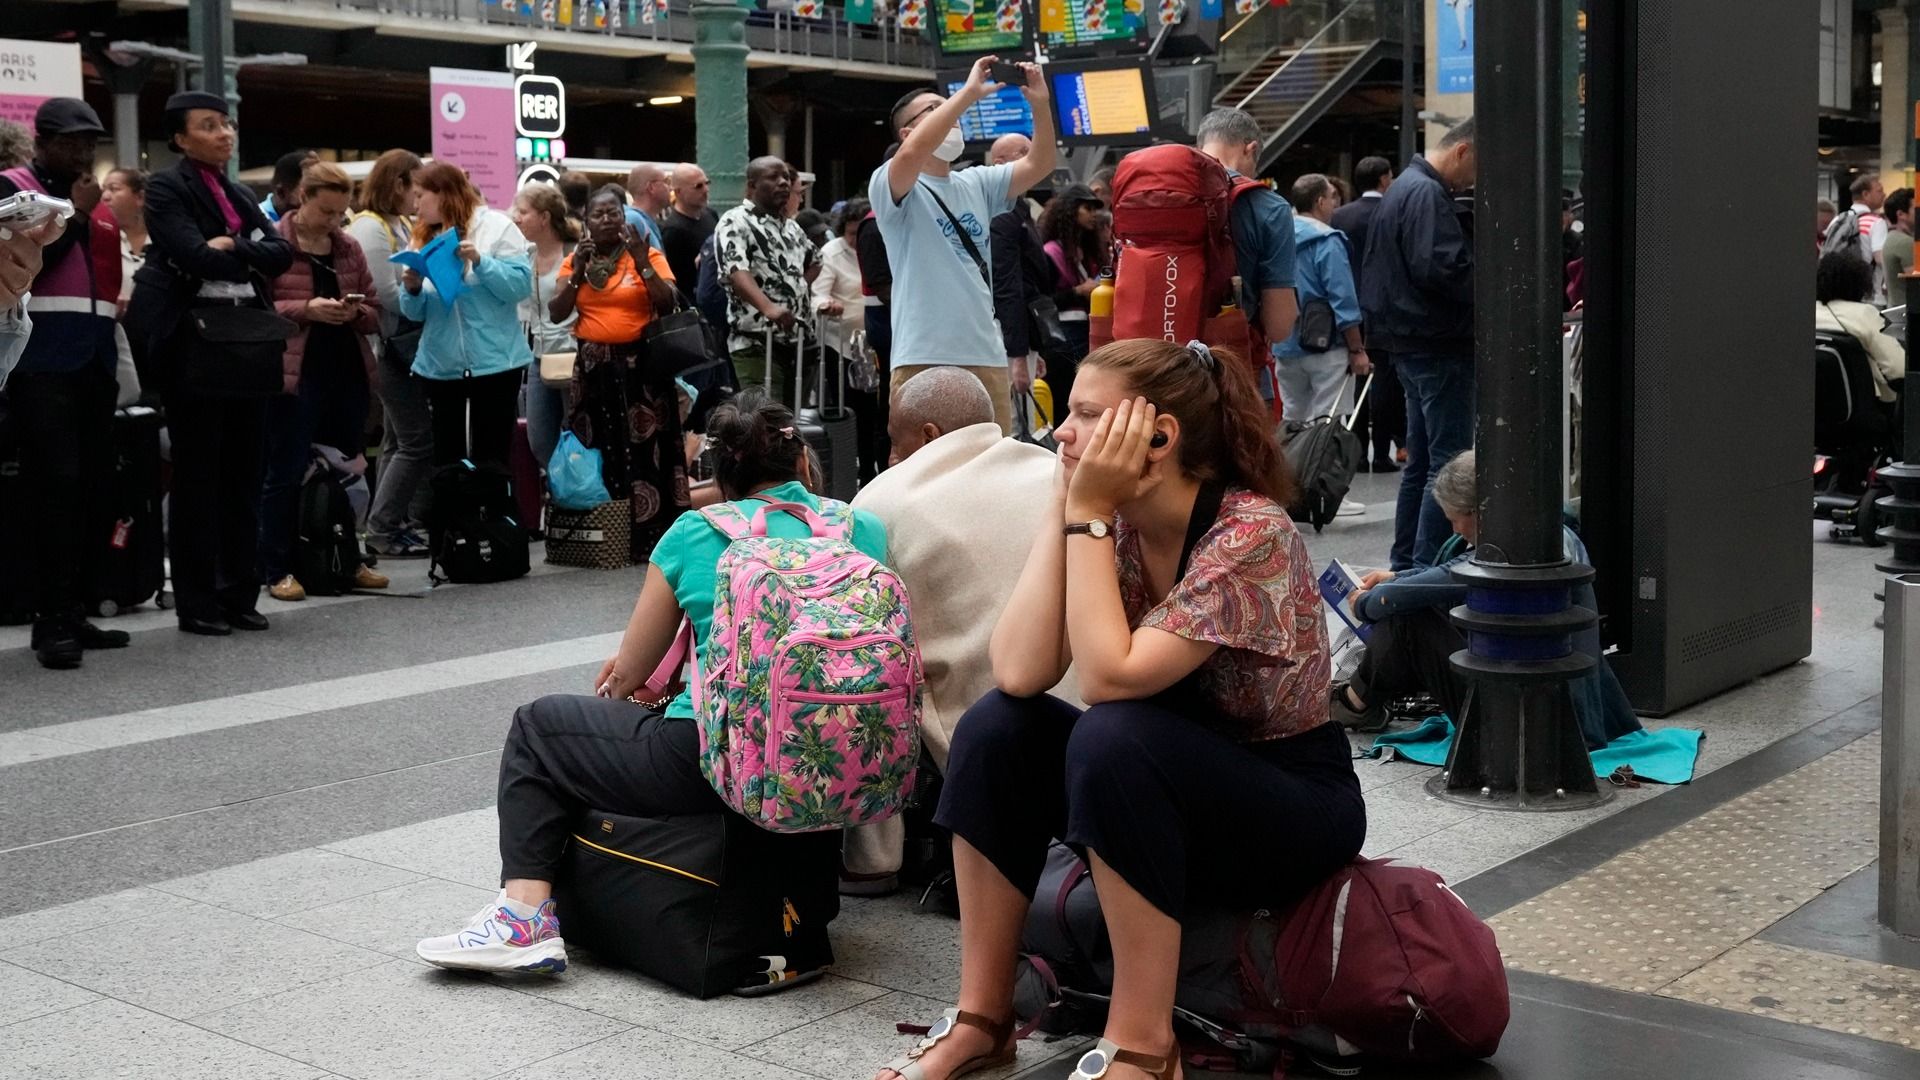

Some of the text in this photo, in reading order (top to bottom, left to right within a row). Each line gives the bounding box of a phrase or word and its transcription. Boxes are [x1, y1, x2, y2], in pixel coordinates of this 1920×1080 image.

[0, 52, 37, 67] ARIS
[2, 68, 37, 81] 024
[522, 93, 558, 120] RER
